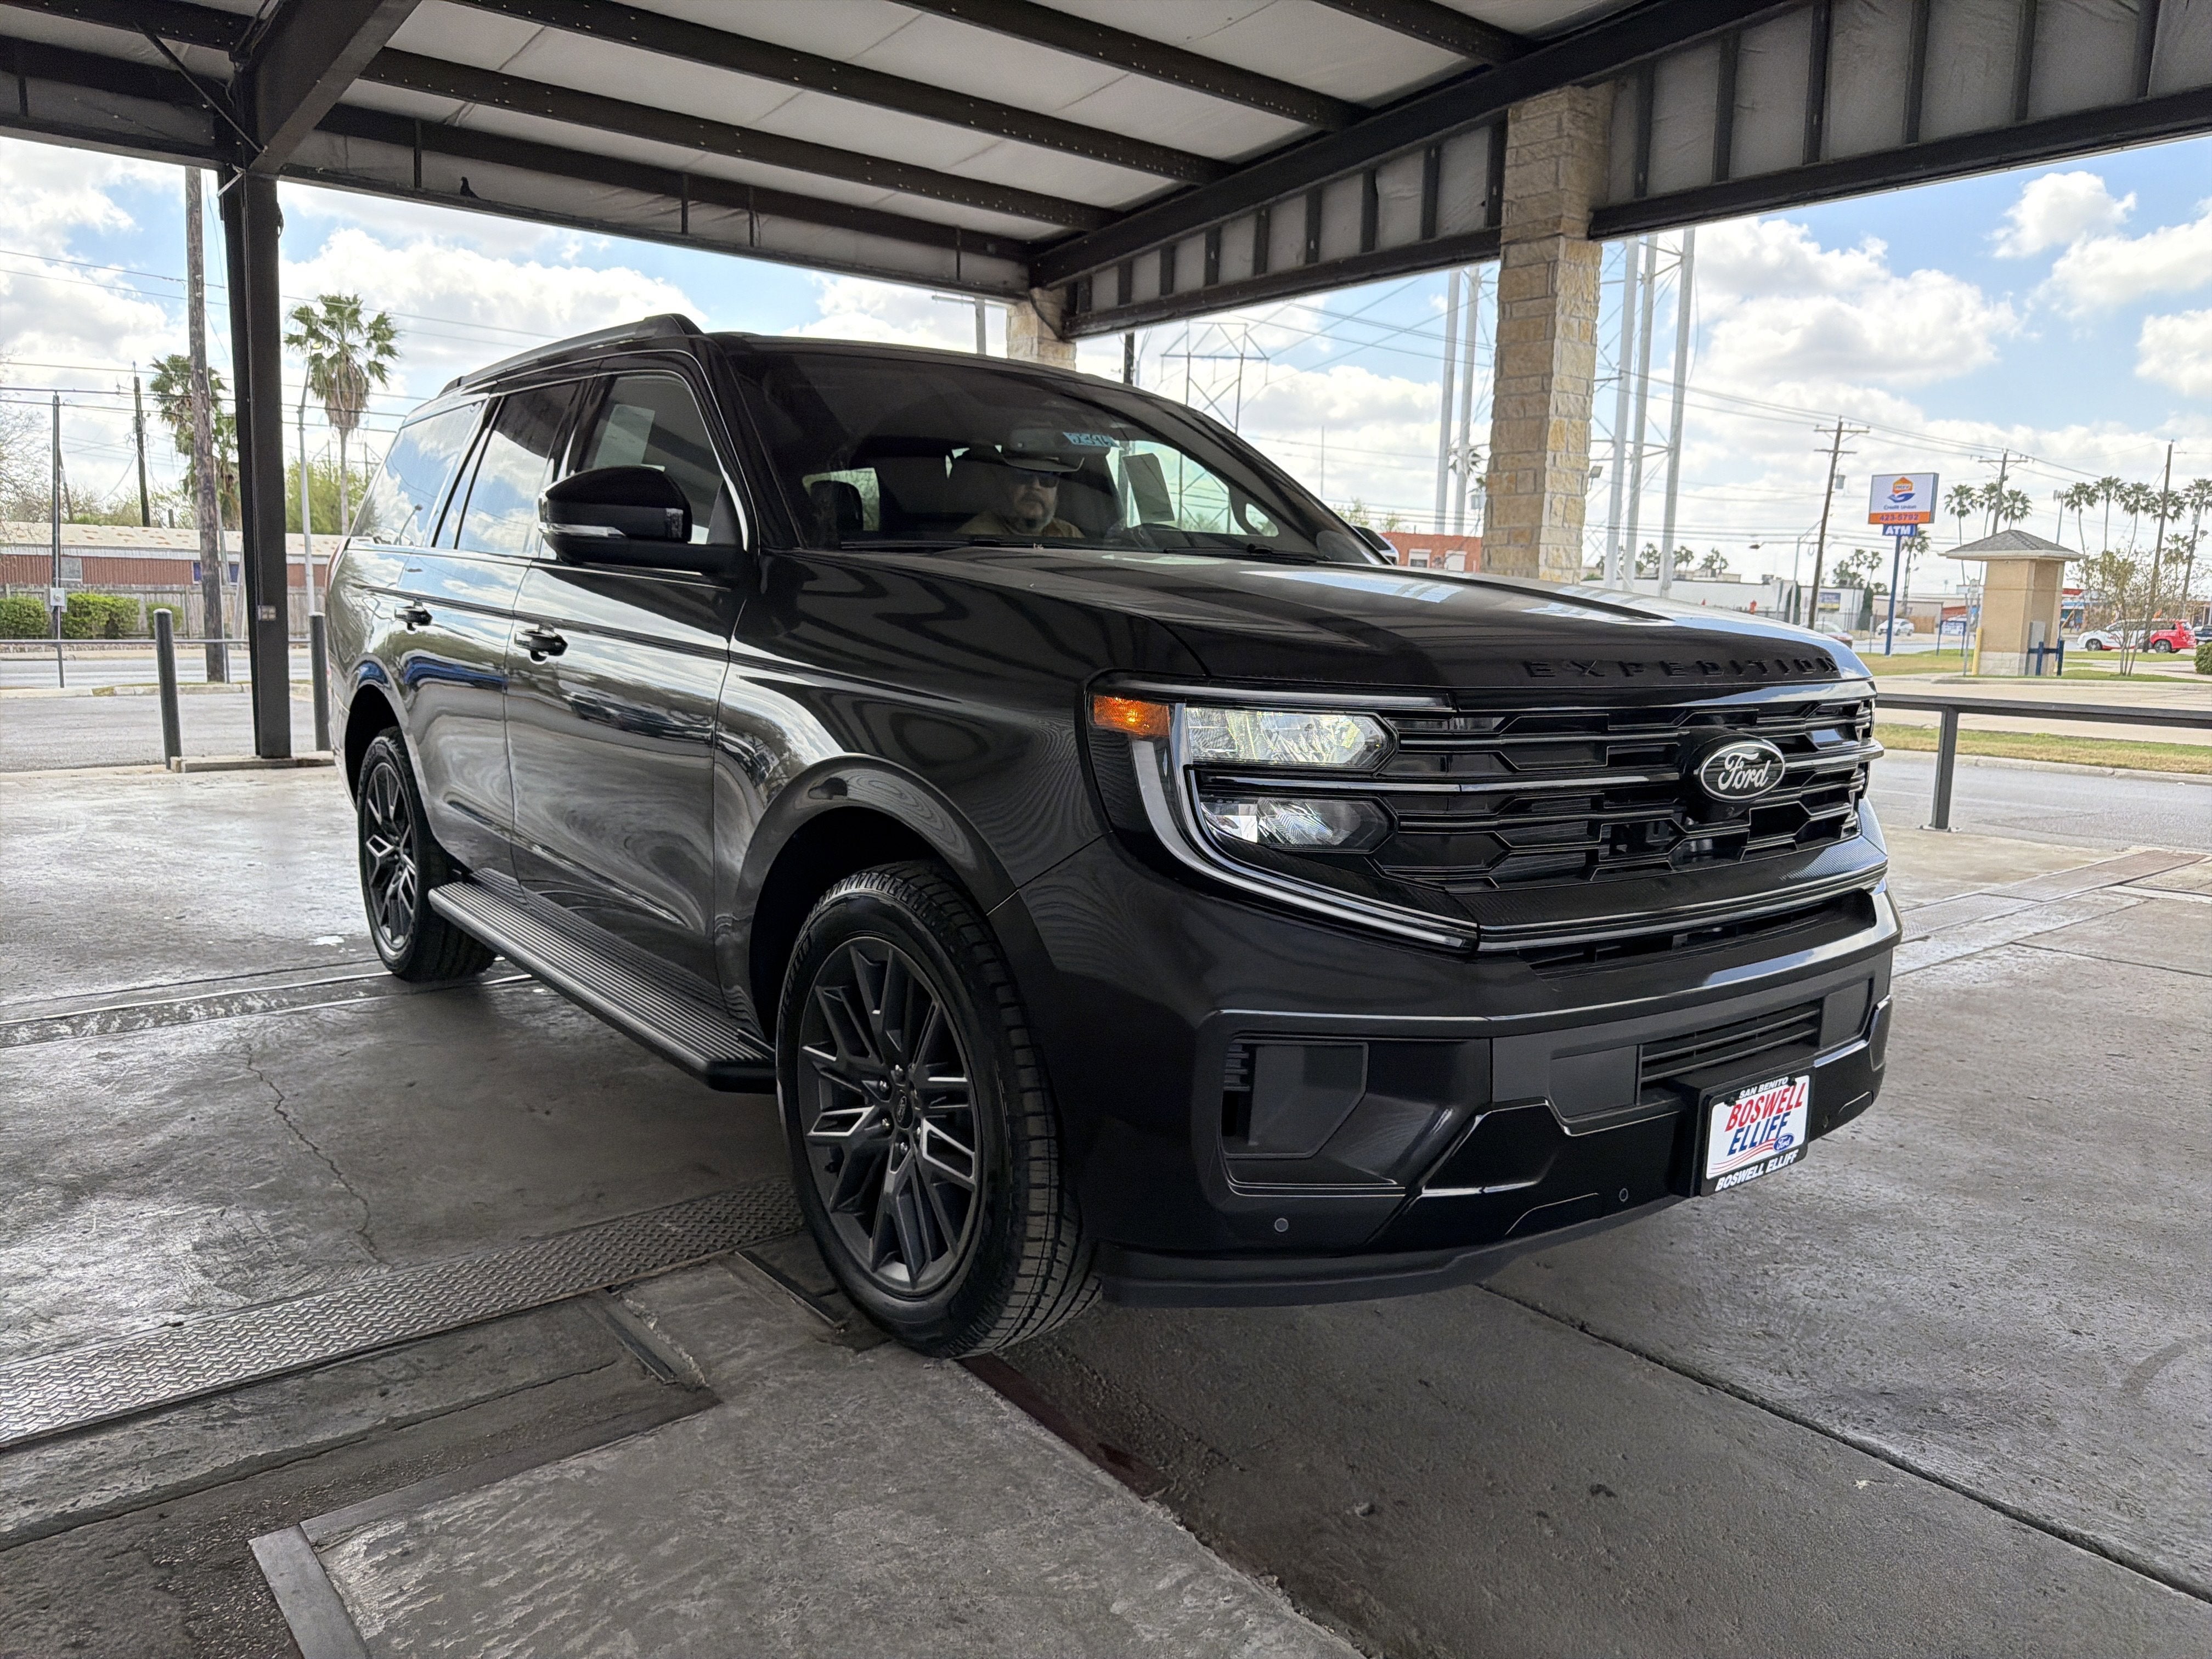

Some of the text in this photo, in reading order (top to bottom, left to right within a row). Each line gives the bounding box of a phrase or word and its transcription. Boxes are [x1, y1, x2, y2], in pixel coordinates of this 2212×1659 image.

[1885, 525, 1911, 535] ATM
[1523, 657, 1839, 678] EXPEDITION
[1718, 752, 1771, 790] Ford
[1739, 1076, 1789, 1099] SAN BENITO
[1724, 1082, 1806, 1132] BOSWELL
[1727, 1111, 1791, 1156] ELLIFF
[1715, 1149, 1799, 1192] BOSWELL ELLIFF
